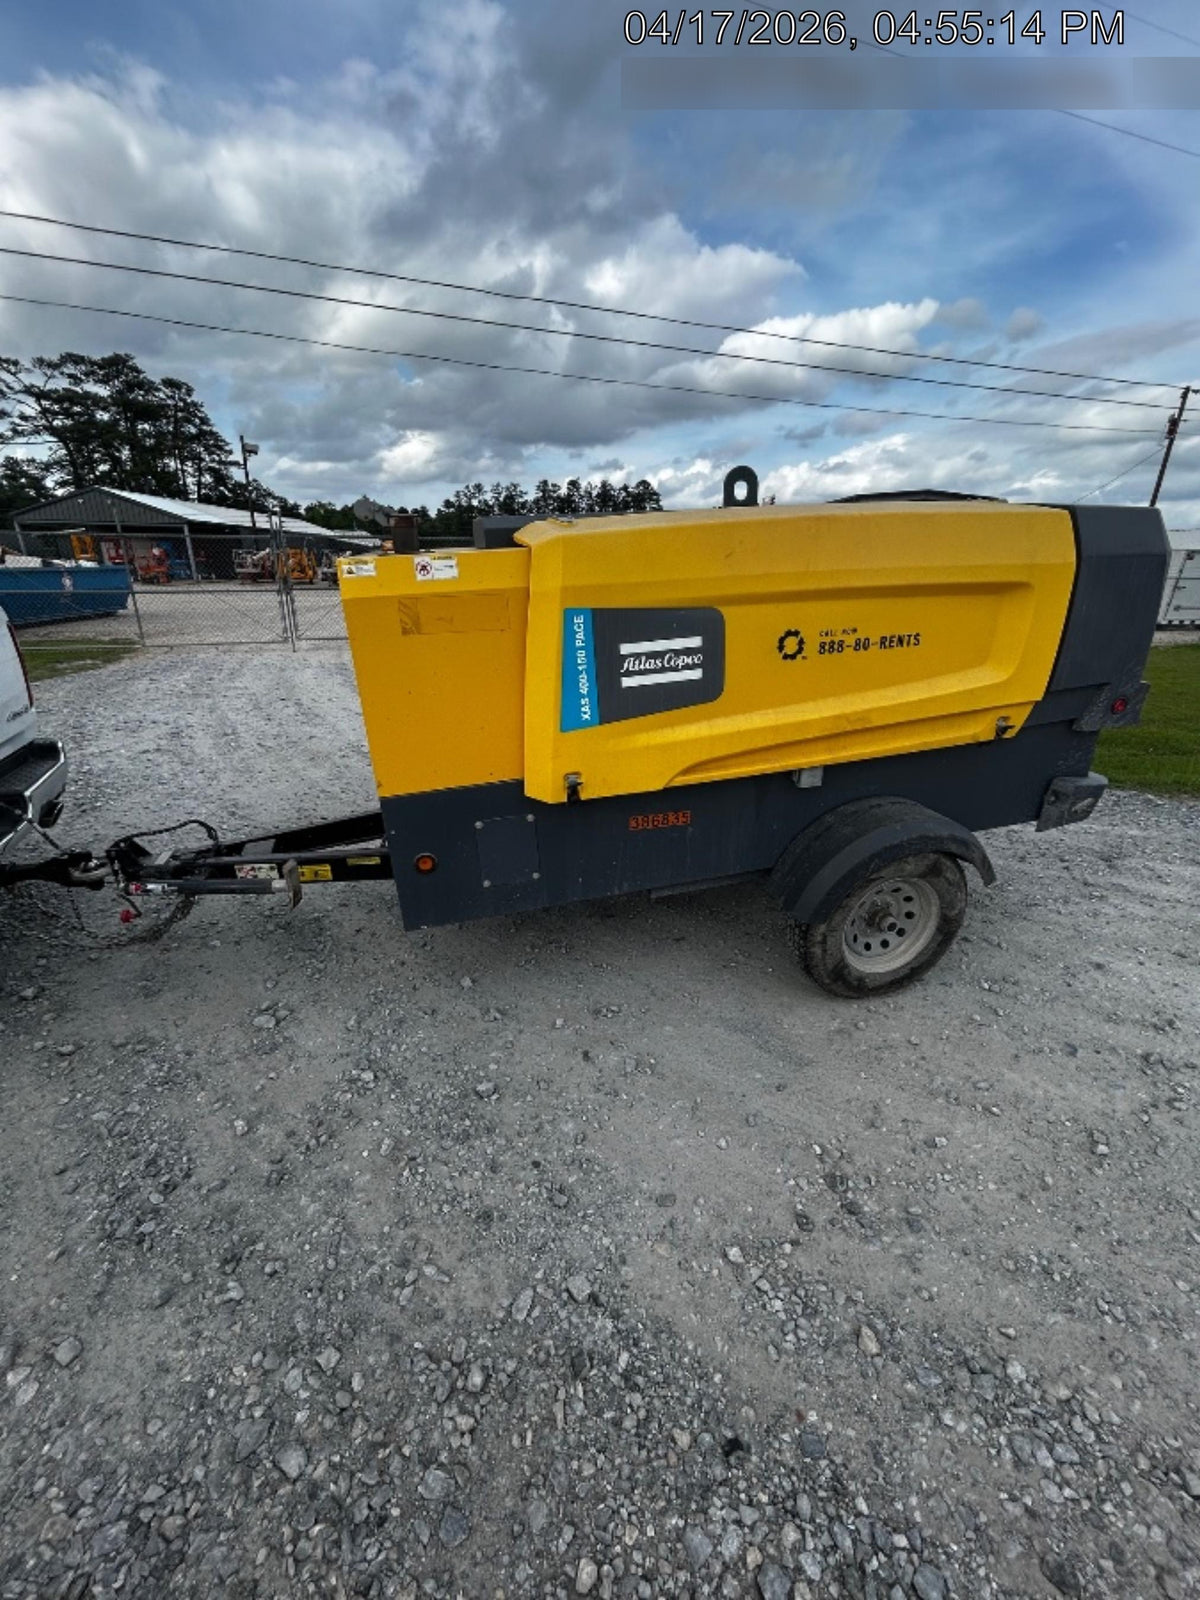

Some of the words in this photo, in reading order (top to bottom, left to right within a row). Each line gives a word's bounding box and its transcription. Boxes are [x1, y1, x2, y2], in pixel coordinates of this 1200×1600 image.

[574, 615, 586, 647] PACE
[620, 655, 662, 673] Atlas
[664, 652, 703, 669] Copco
[580, 697, 591, 721] XAS
